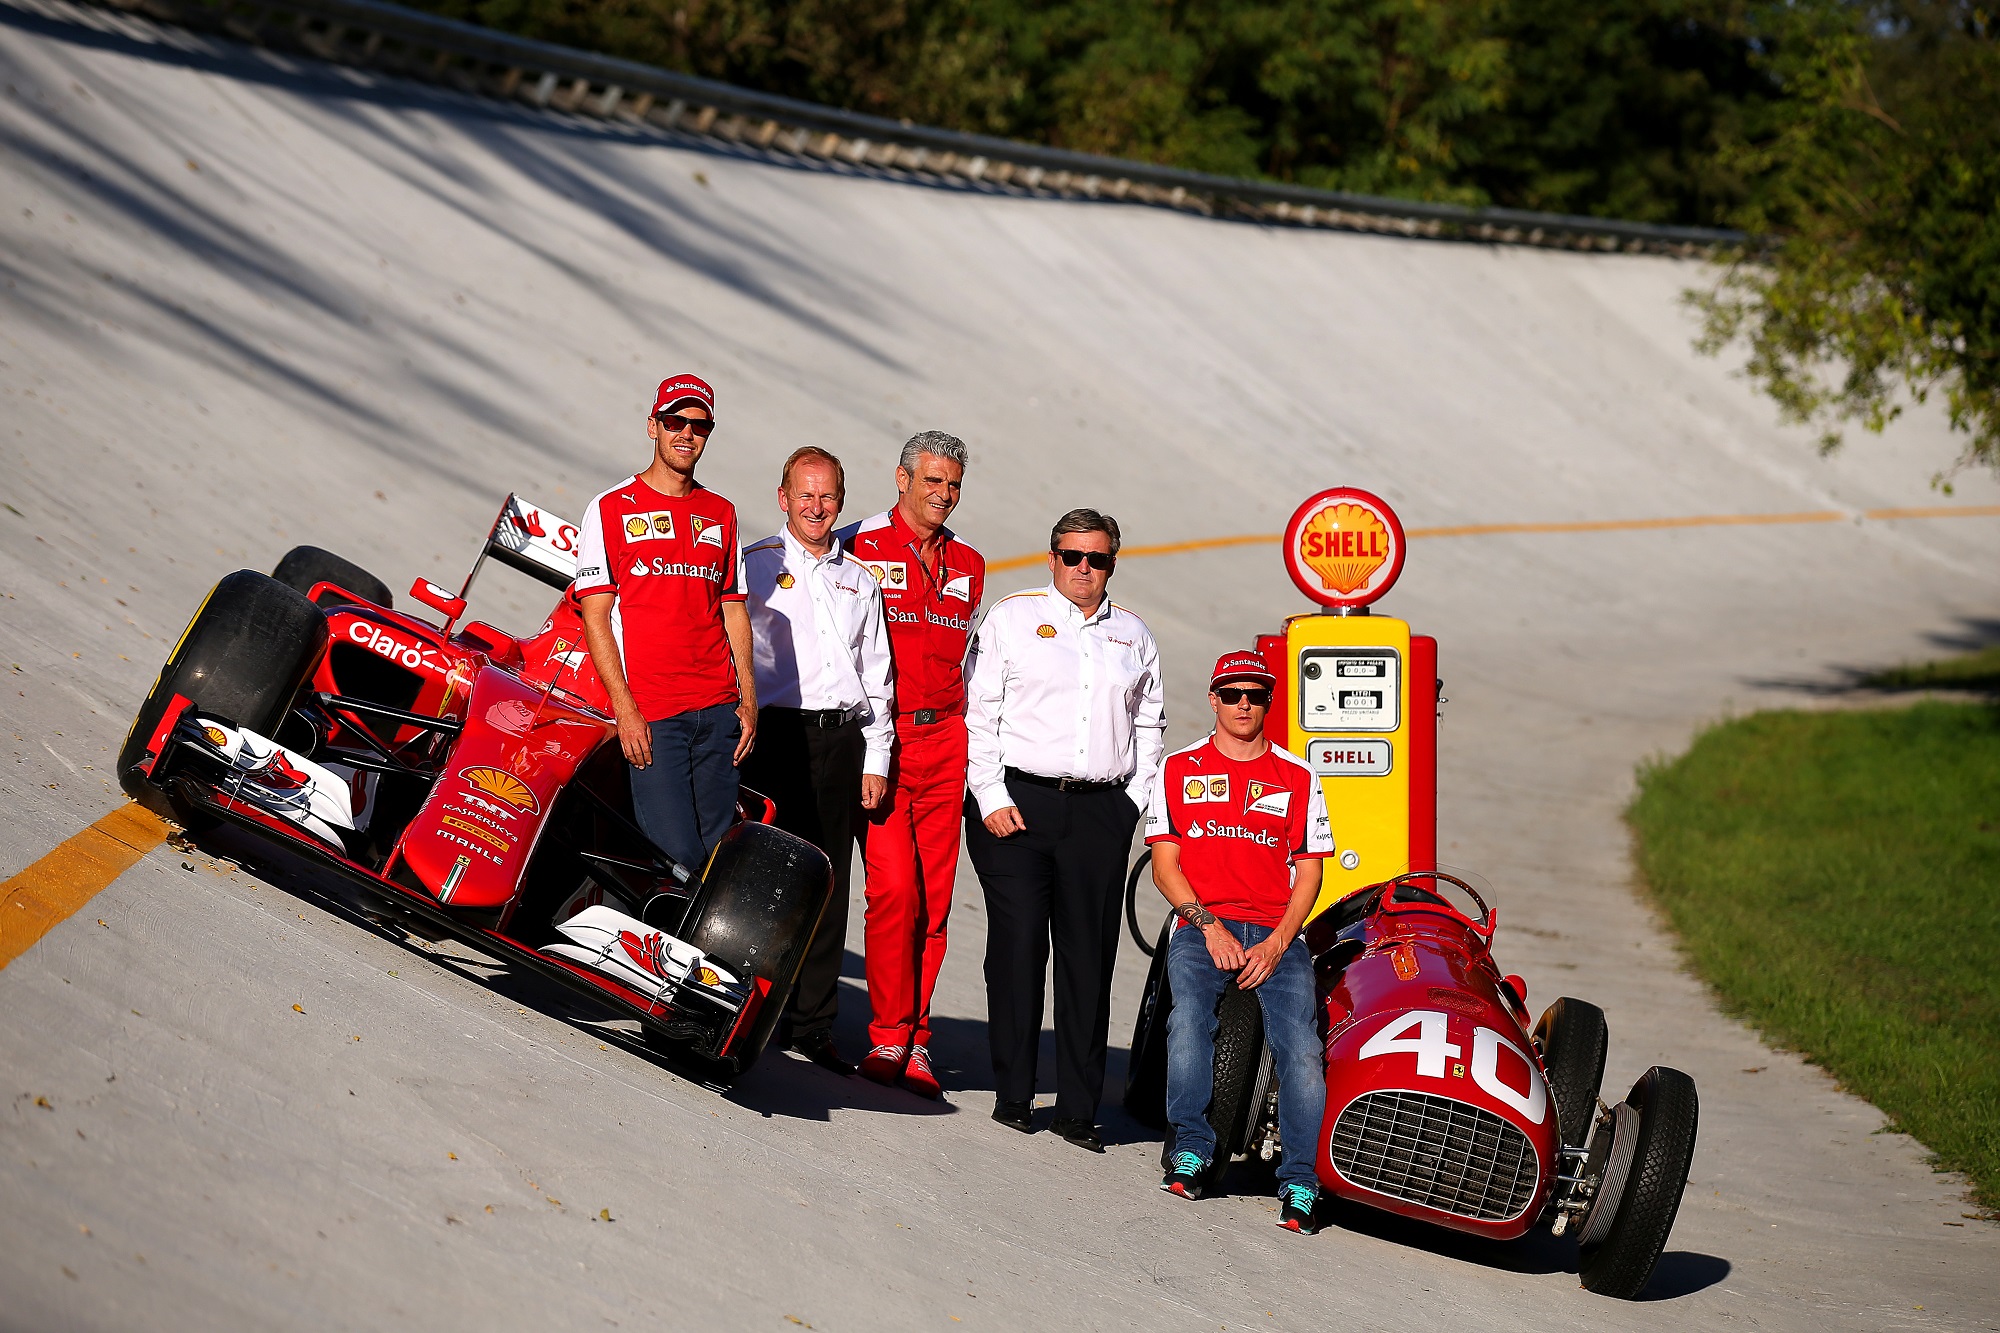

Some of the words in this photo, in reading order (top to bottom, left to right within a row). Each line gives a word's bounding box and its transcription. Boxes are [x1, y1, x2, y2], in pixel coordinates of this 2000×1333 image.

[675, 383, 711, 399] Santander
[655, 520, 670, 532] ups
[1307, 531, 1382, 557] SHELL
[652, 557, 722, 583] Santander
[890, 571, 904, 581] ups
[349, 621, 421, 668] Claro
[1230, 660, 1266, 670] Santander
[1322, 751, 1376, 764] SHELL
[1210, 783, 1226, 793] ups
[458, 791, 517, 821] TNT
[442, 803, 512, 838] KASPERSKY
[436, 829, 504, 866] MAHLE
[1359, 1010, 1546, 1125] 40
